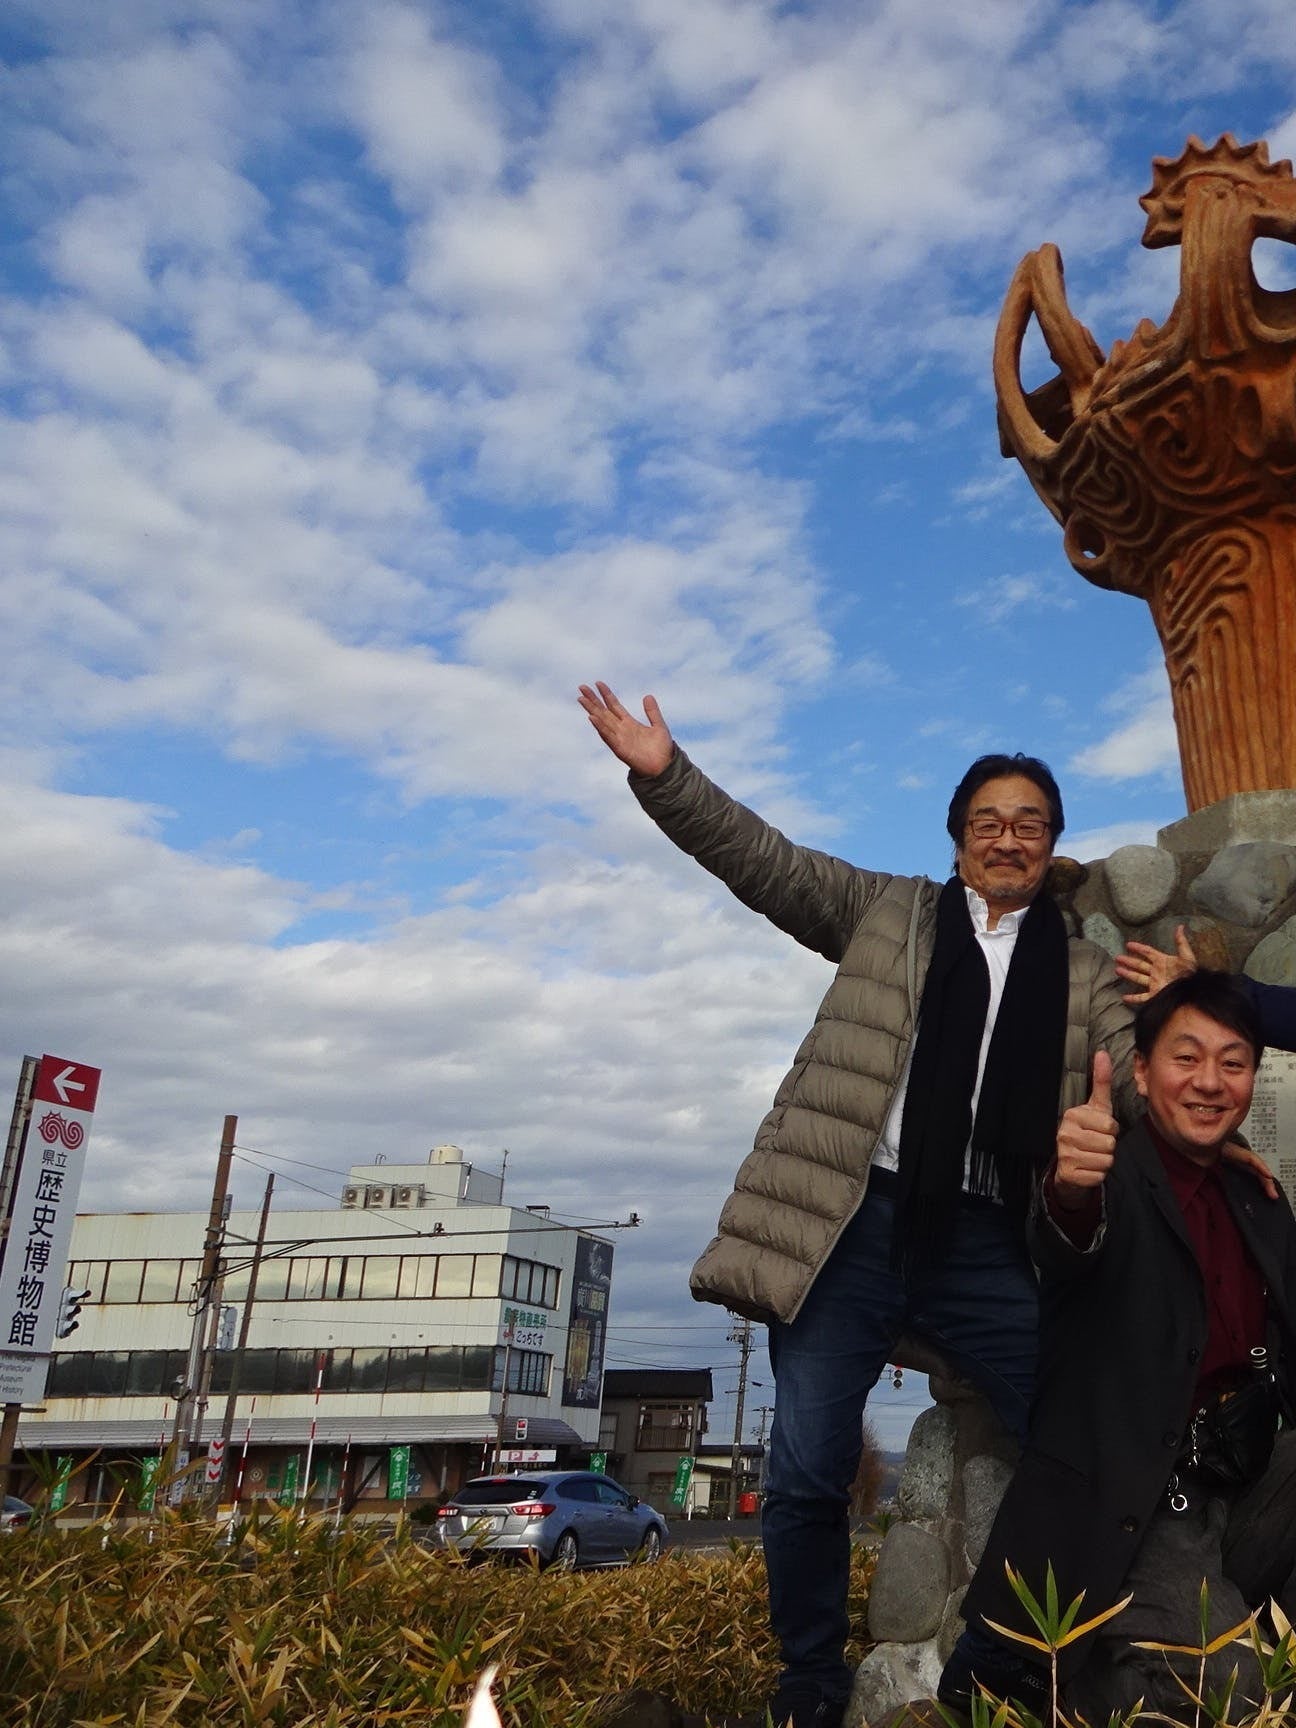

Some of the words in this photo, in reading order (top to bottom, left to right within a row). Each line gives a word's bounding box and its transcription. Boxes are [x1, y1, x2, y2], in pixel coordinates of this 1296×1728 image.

[41, 1149, 69, 1168] 県立
[8, 1168, 65, 1347] 歴史博物館
